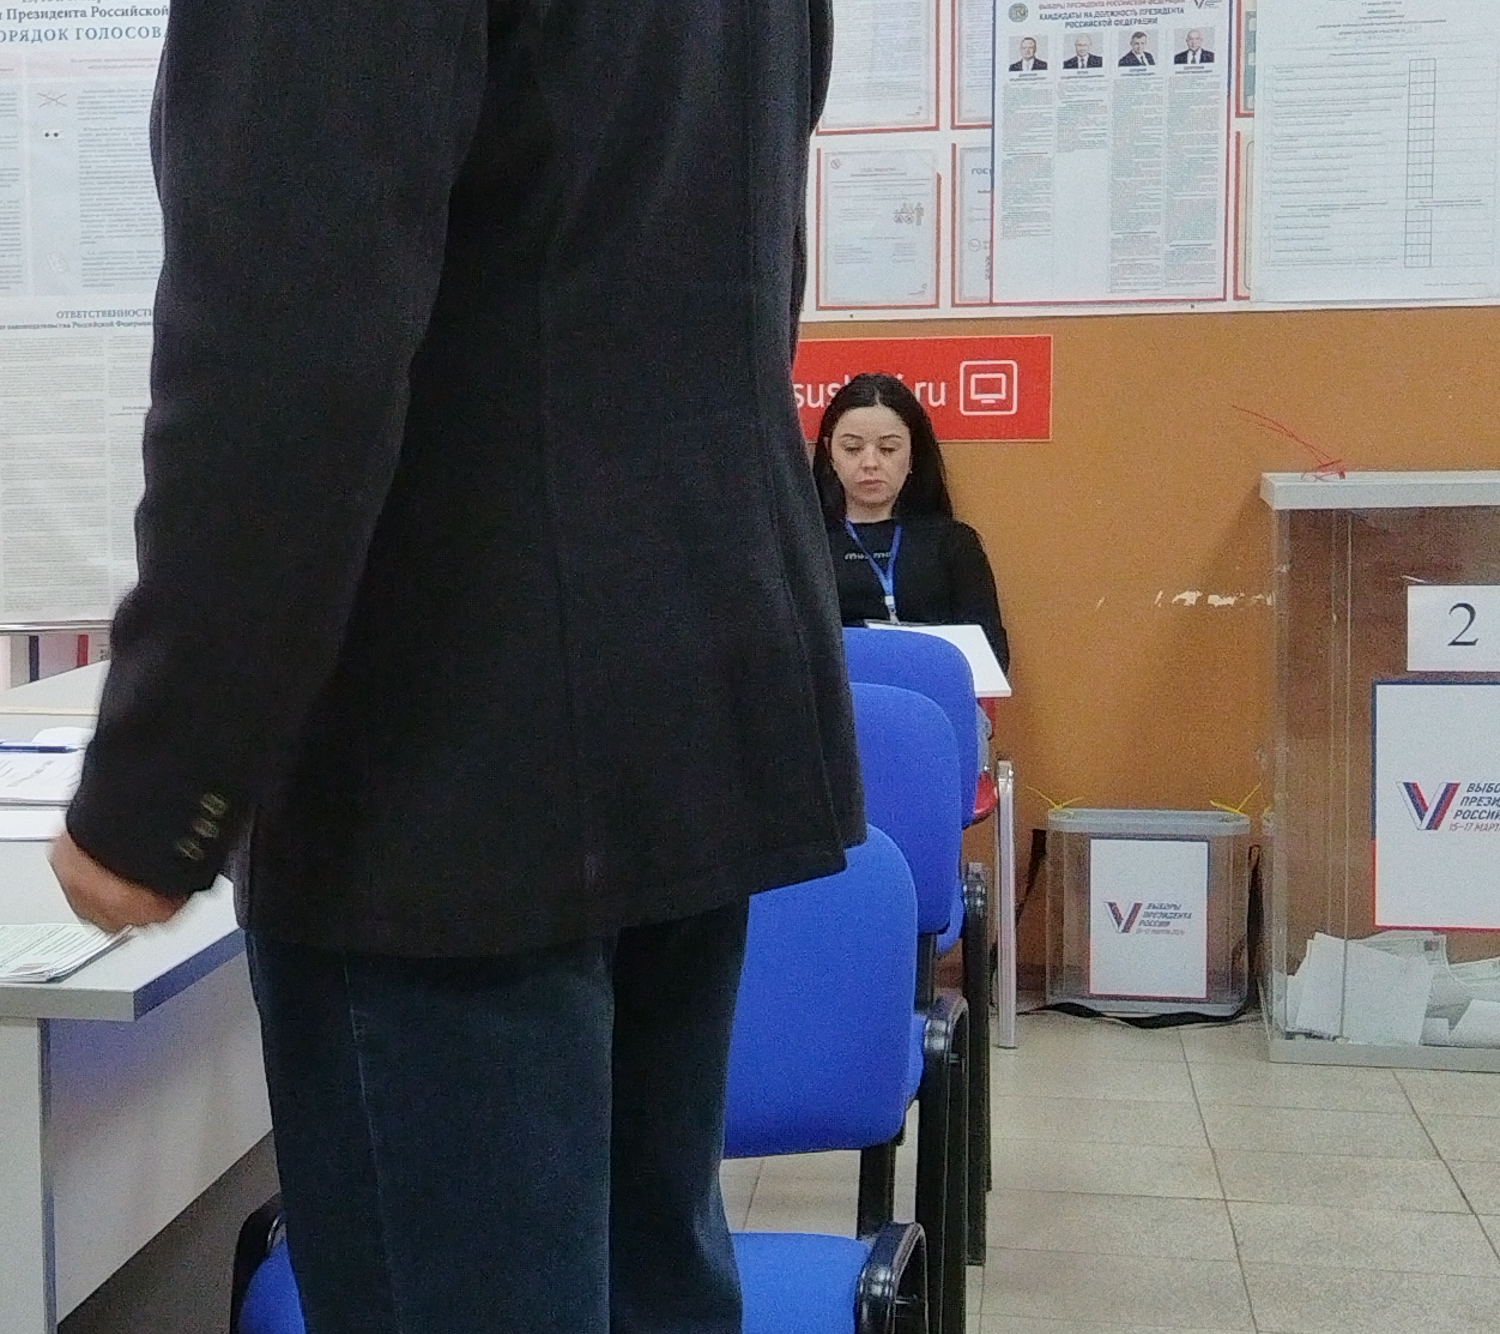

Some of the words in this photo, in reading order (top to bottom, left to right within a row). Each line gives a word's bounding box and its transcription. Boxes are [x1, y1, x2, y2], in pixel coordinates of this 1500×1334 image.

[6, 8, 87, 23] Президента
[90, 5, 169, 18] Российской
[75, 26, 167, 41] ГОЛОСОВ
[1447, 602, 1479, 646] 2
